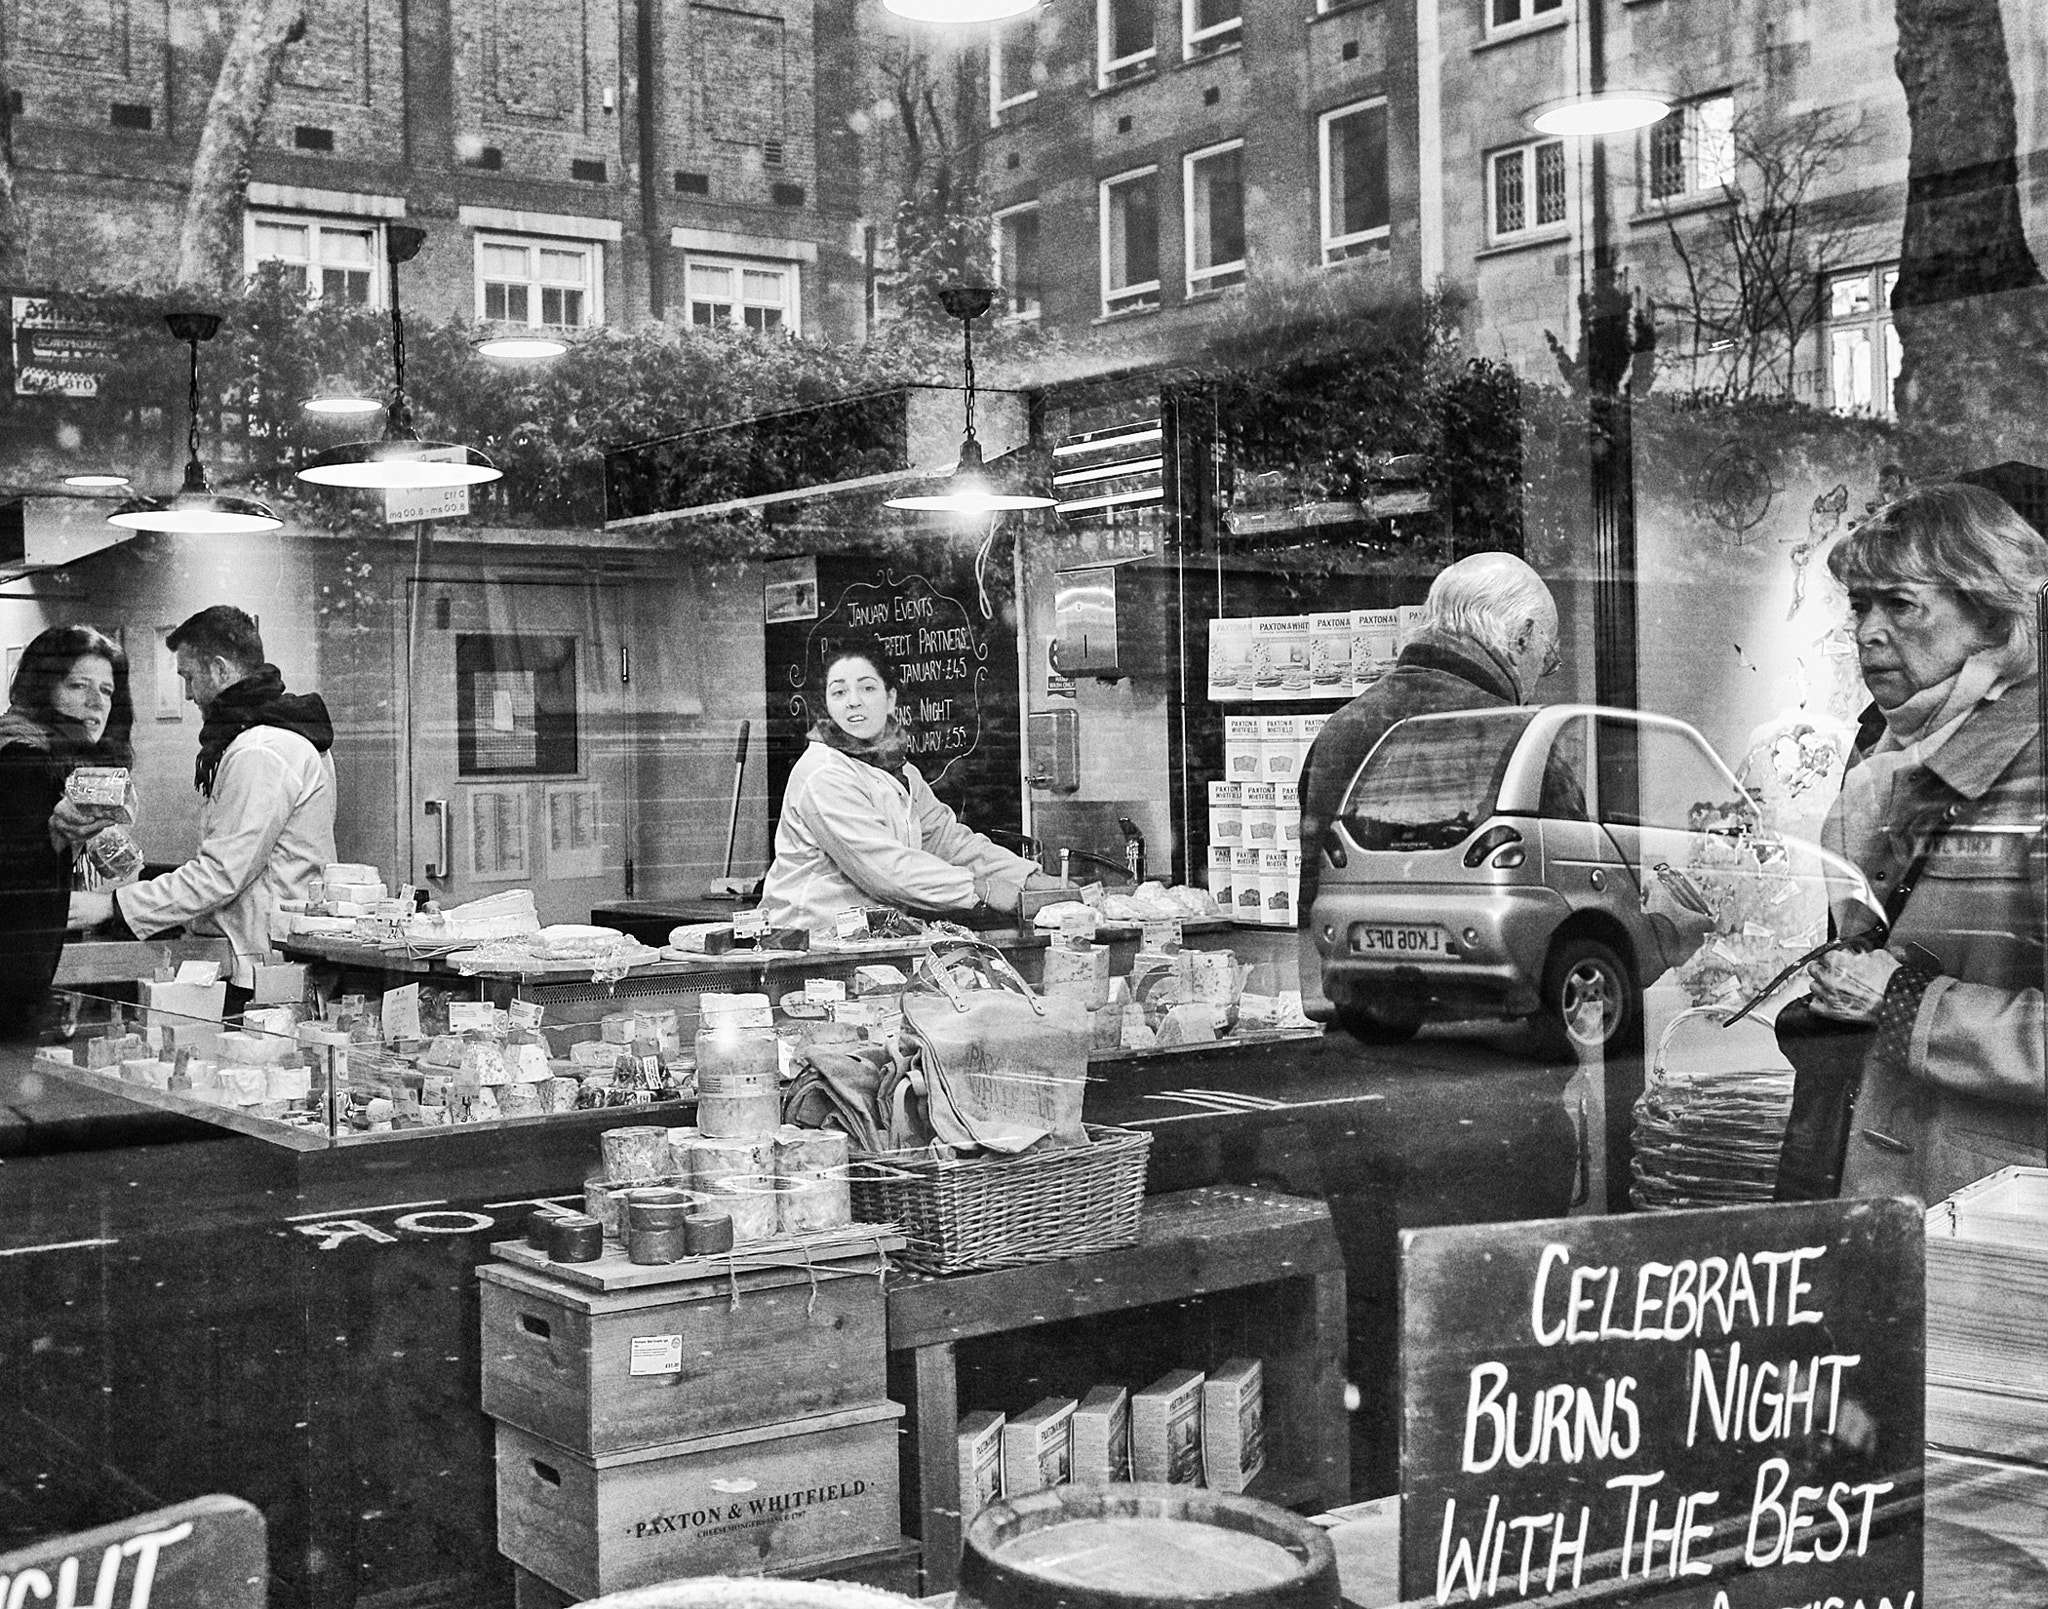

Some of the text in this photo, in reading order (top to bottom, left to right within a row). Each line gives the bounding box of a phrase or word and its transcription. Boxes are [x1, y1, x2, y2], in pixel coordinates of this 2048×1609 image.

[847, 596, 934, 627] JANUARY EVENTS
[920, 697, 953, 723] NIGHT
[1532, 1243, 1827, 1347] CELEBRATE
[1463, 1342, 1861, 1474] BURNS NIGHT
[635, 1479, 866, 1539] PAXTON & WHITFIELD
[1436, 1458, 1894, 1603] WITH THE BEST
